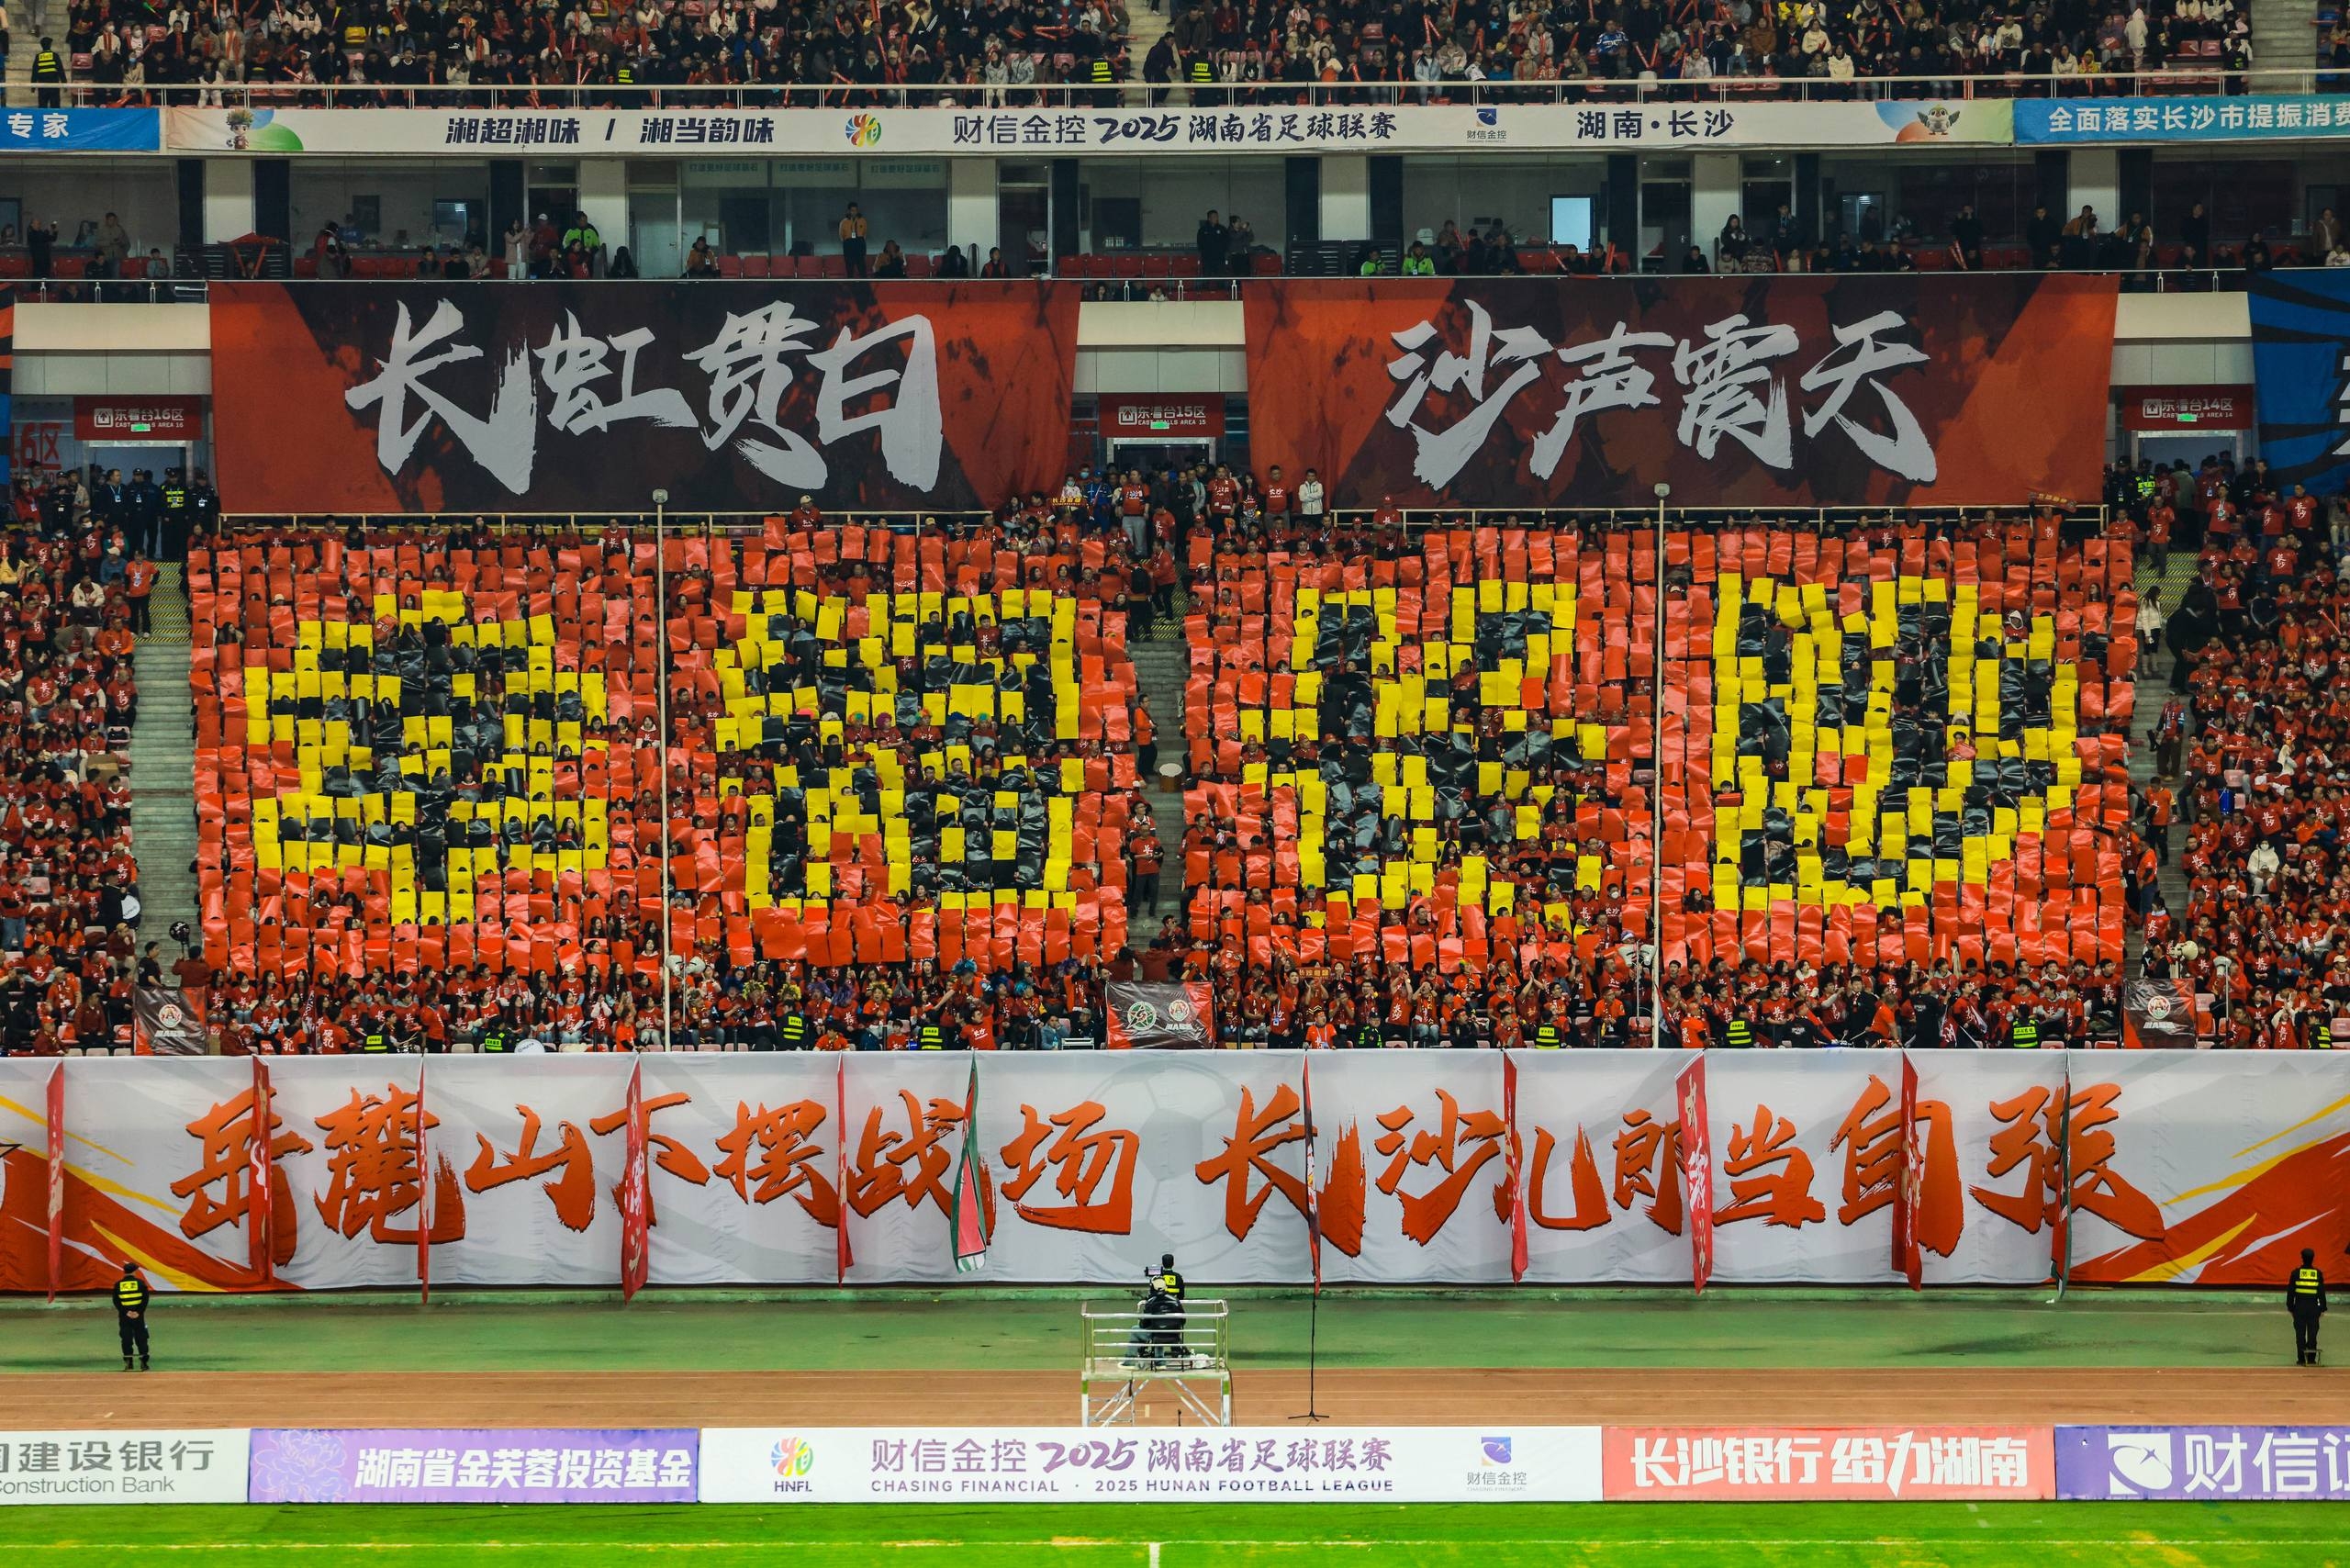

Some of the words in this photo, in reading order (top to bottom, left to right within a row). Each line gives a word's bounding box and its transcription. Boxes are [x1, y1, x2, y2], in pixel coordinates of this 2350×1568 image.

[7, 112, 69, 139] 专家
[445, 117, 580, 144] 湘超湘味
[639, 117, 775, 144] 湘当韵味
[953, 115, 1086, 144] 财信金控
[1092, 116, 1178, 142] 2025
[1188, 112, 1396, 143] 湖南省足球联赛
[1577, 108, 1734, 140] 湖南·长沙
[2049, 103, 2350, 132] 全面落实长沙市提振消费
[1467, 129, 1506, 139] 财信金控
[344, 297, 944, 495] 长虹贯日
[1384, 298, 1938, 491] 沙声震天
[1137, 406, 1206, 419] 东看台15区
[0, 1439, 214, 1473] 建设银行
[354, 1447, 692, 1491] 湖南省金芙蓉投资基金
[871, 1438, 1026, 1473] 财信金控
[1035, 1438, 1138, 1473] 2025
[1147, 1437, 1393, 1473] 湖南省足球联赛
[1630, 1437, 1823, 1486] 长沙银行
[1830, 1430, 2028, 1497] 给力湖南
[0, 1476, 115, 1495] onstruction
[122, 1476, 175, 1493] Bank
[774, 1481, 813, 1492] HNFL
[871, 1480, 953, 1492] CHASING
[961, 1480, 1059, 1492] FINANCIAL
[1095, 1480, 1137, 1492] 2025
[1147, 1480, 1210, 1492] HUNAN
[1218, 1480, 1314, 1492] FOOTBALL
[1322, 1480, 1393, 1492] LEAGUE
[1467, 1471, 1528, 1485] 财信金控
